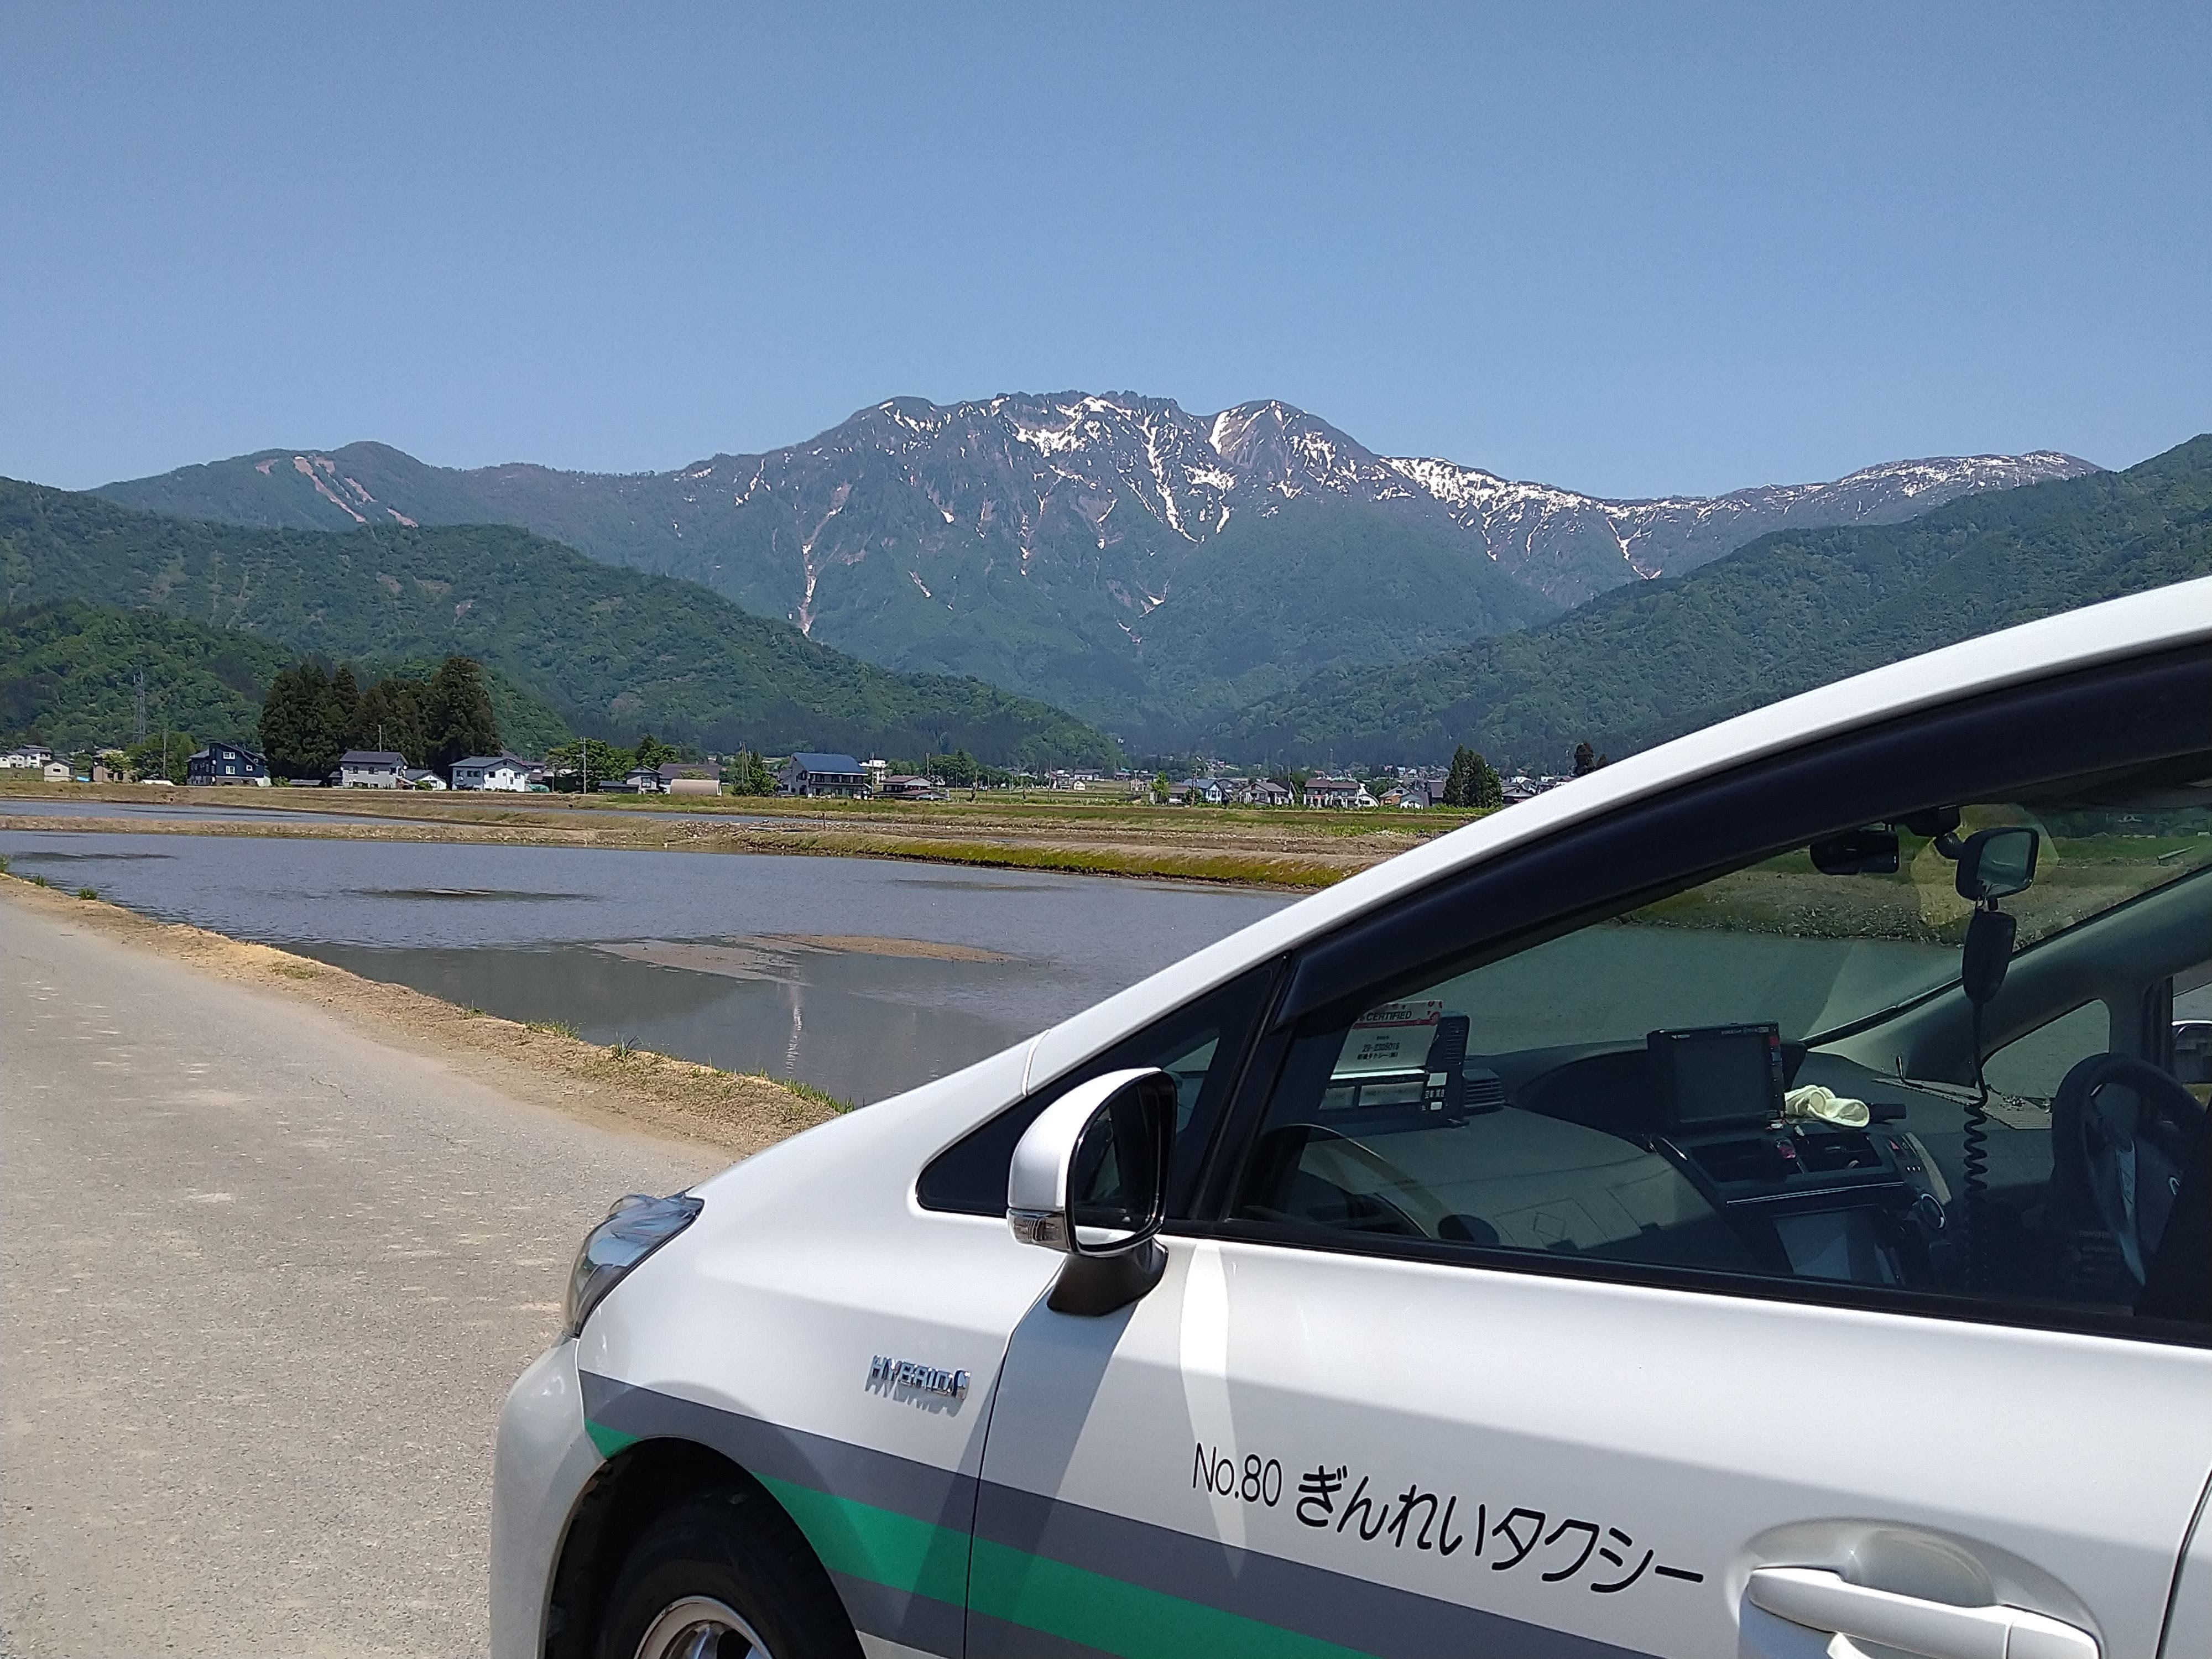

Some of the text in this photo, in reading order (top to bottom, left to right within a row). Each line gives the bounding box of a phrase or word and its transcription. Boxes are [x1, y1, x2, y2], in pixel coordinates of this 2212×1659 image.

[1366, 1011, 1412, 1021] CERTIFIED
[869, 1355, 953, 1395] HYBRID
[1193, 1442, 1704, 1593] No.80 ぎんれいタクシー
